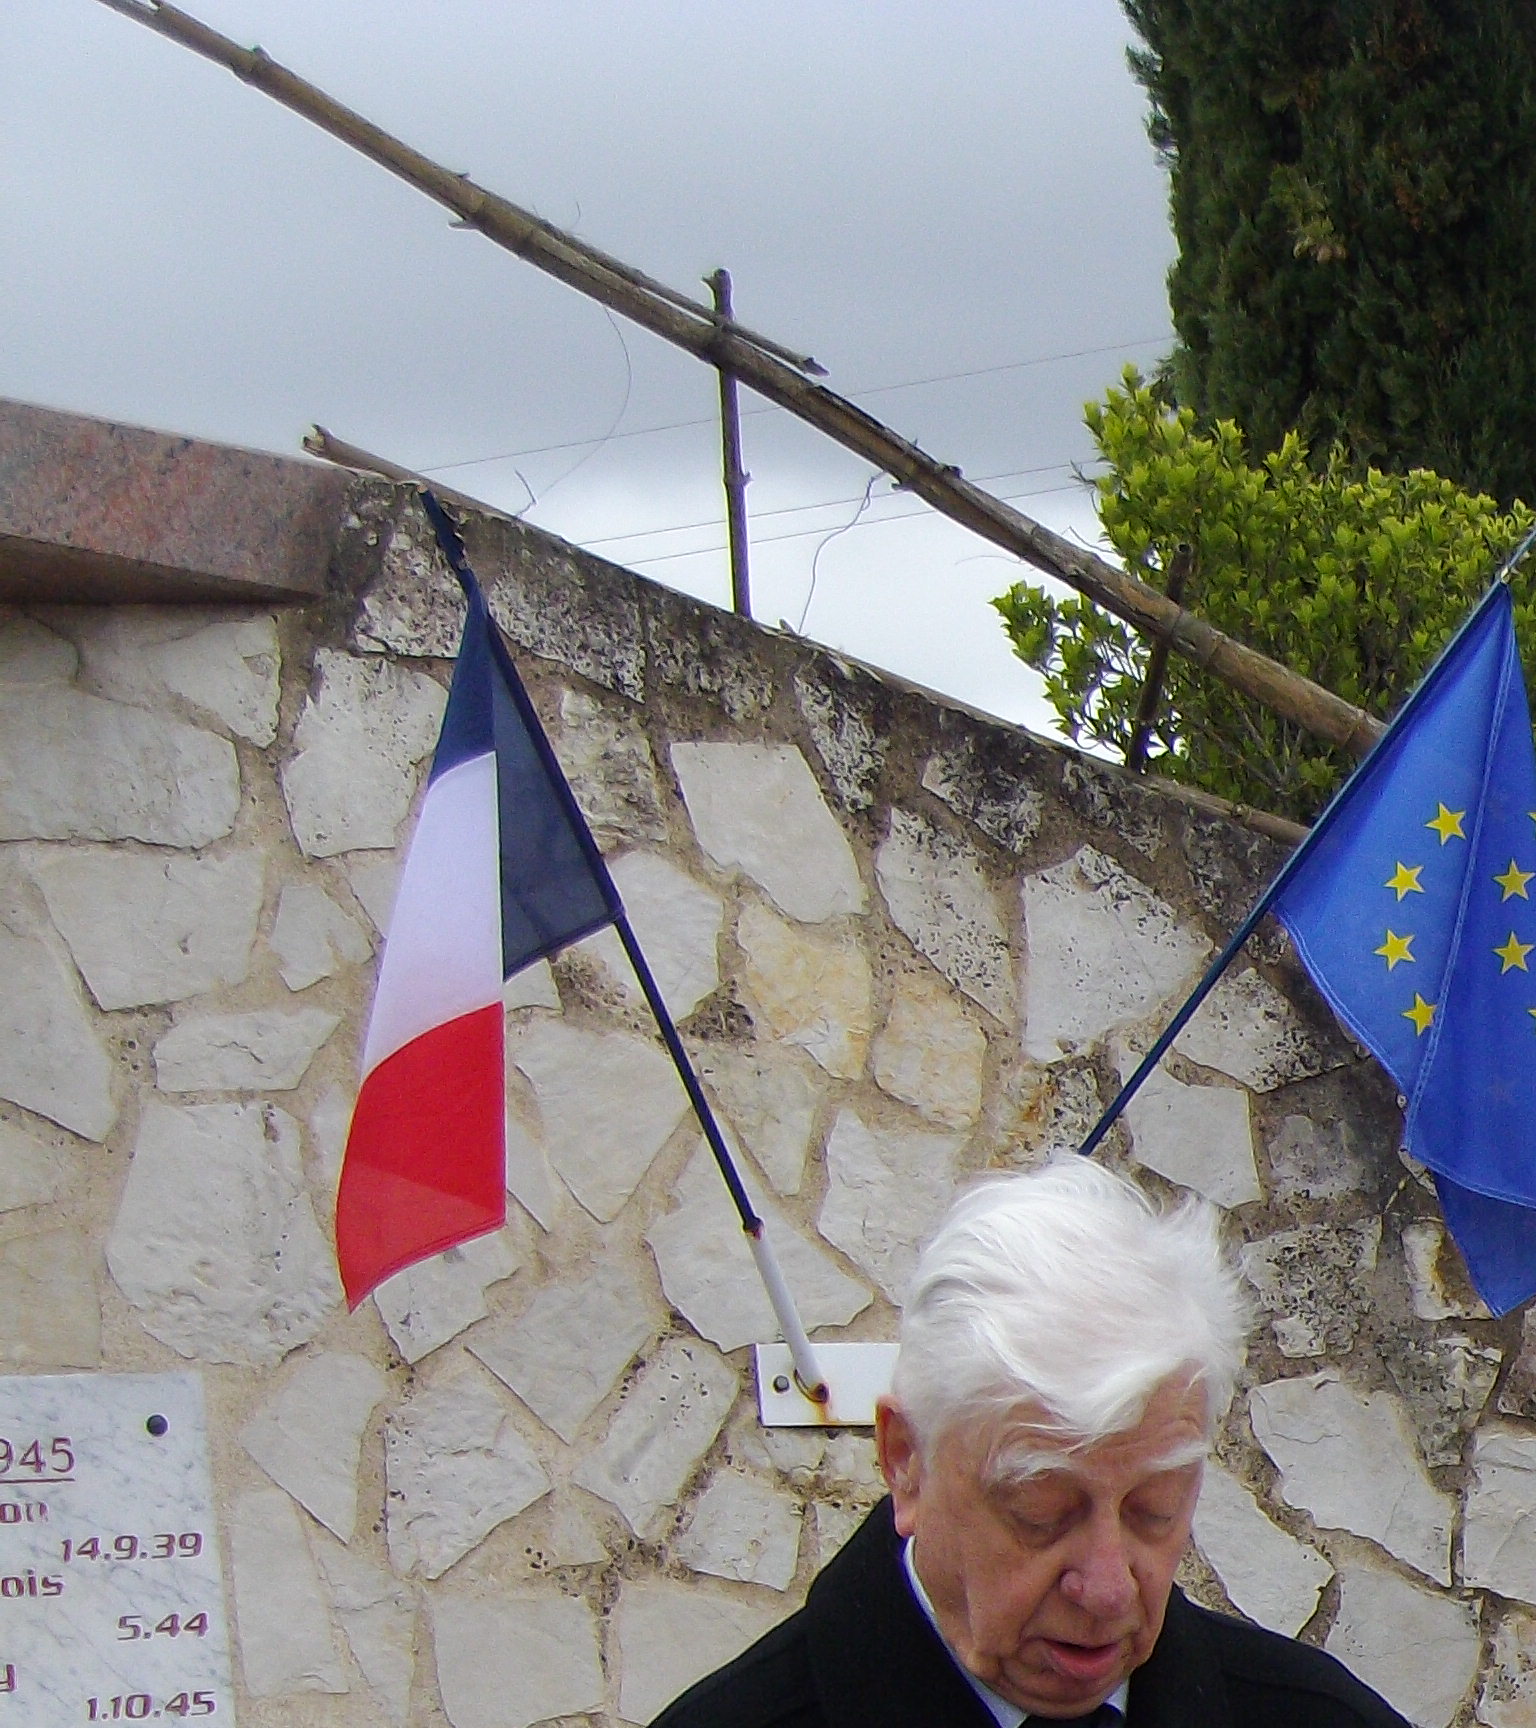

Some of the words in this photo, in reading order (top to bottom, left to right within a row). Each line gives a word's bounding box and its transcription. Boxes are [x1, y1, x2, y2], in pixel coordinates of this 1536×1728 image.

[61, 1532, 204, 1563] 14.9.39
[0, 1568, 65, 1598] ois
[117, 1611, 210, 1641] 5.44
[87, 1691, 216, 1721] 1.10.45
